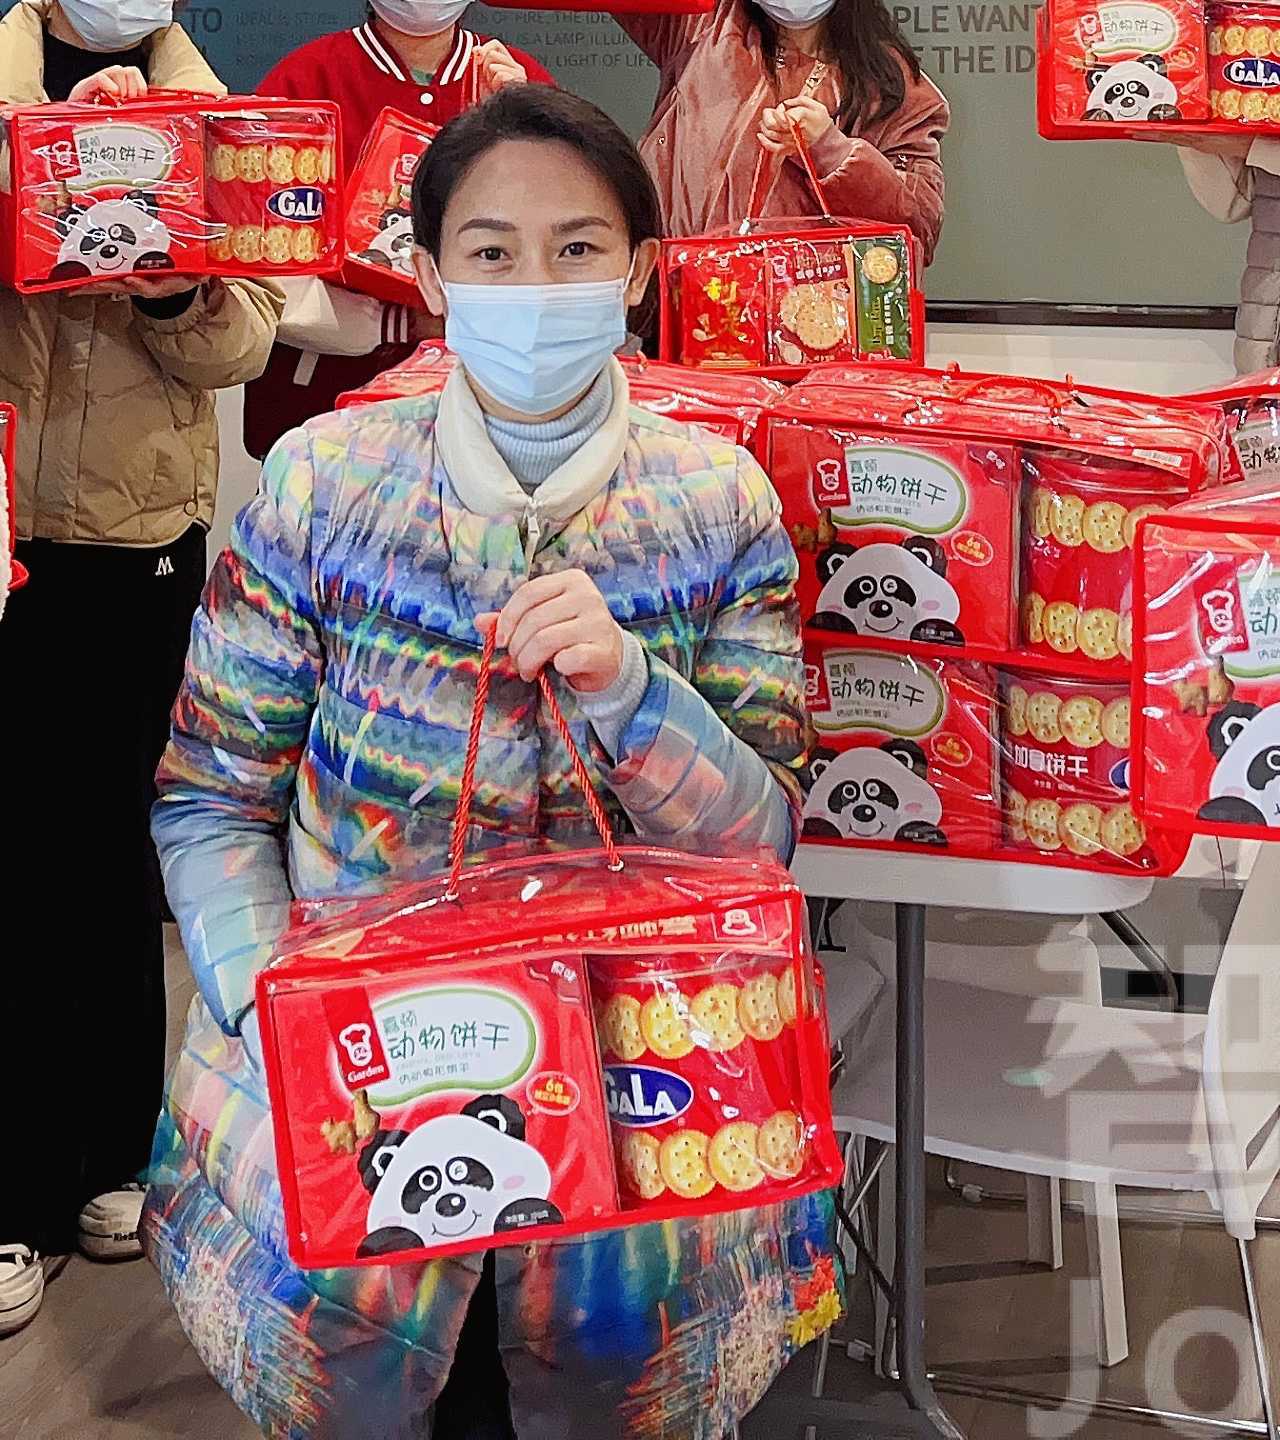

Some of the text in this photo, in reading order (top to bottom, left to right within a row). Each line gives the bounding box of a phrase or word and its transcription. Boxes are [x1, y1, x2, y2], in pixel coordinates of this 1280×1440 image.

[186, 7, 222, 33] TO
[553, 11, 581, 25] THE
[545, 33, 585, 47] LAMP
[931, 45, 996, 75] THE
[851, 472, 948, 505] 动物饼干
[830, 676, 926, 708] 动物饼干
[387, 1020, 511, 1060] 动物饼干
[346, 1064, 385, 1084] Garden
